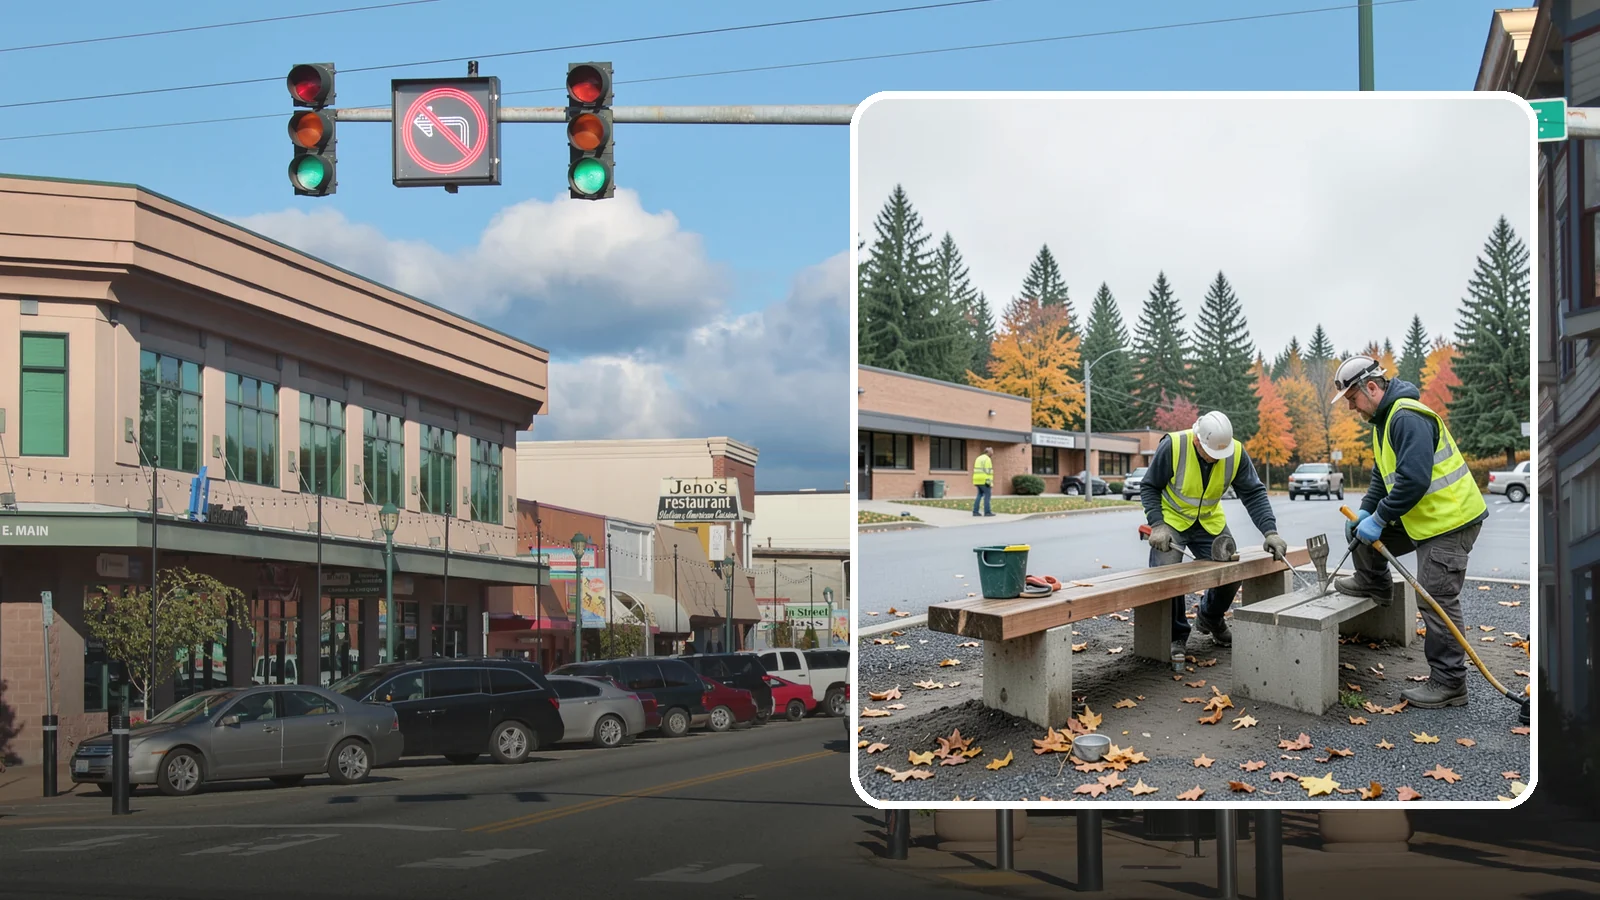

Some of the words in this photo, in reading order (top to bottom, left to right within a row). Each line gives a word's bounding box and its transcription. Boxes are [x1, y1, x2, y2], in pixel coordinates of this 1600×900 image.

[670, 480, 727, 494] Jeno's
[665, 496, 731, 509] restaurant
[658, 510, 682, 519] Italian
[686, 510, 715, 519] American
[715, 510, 738, 519] Cuisine
[2, 525, 13, 536] E.
[15, 525, 49, 536] MAIN
[797, 607, 829, 617] Street
